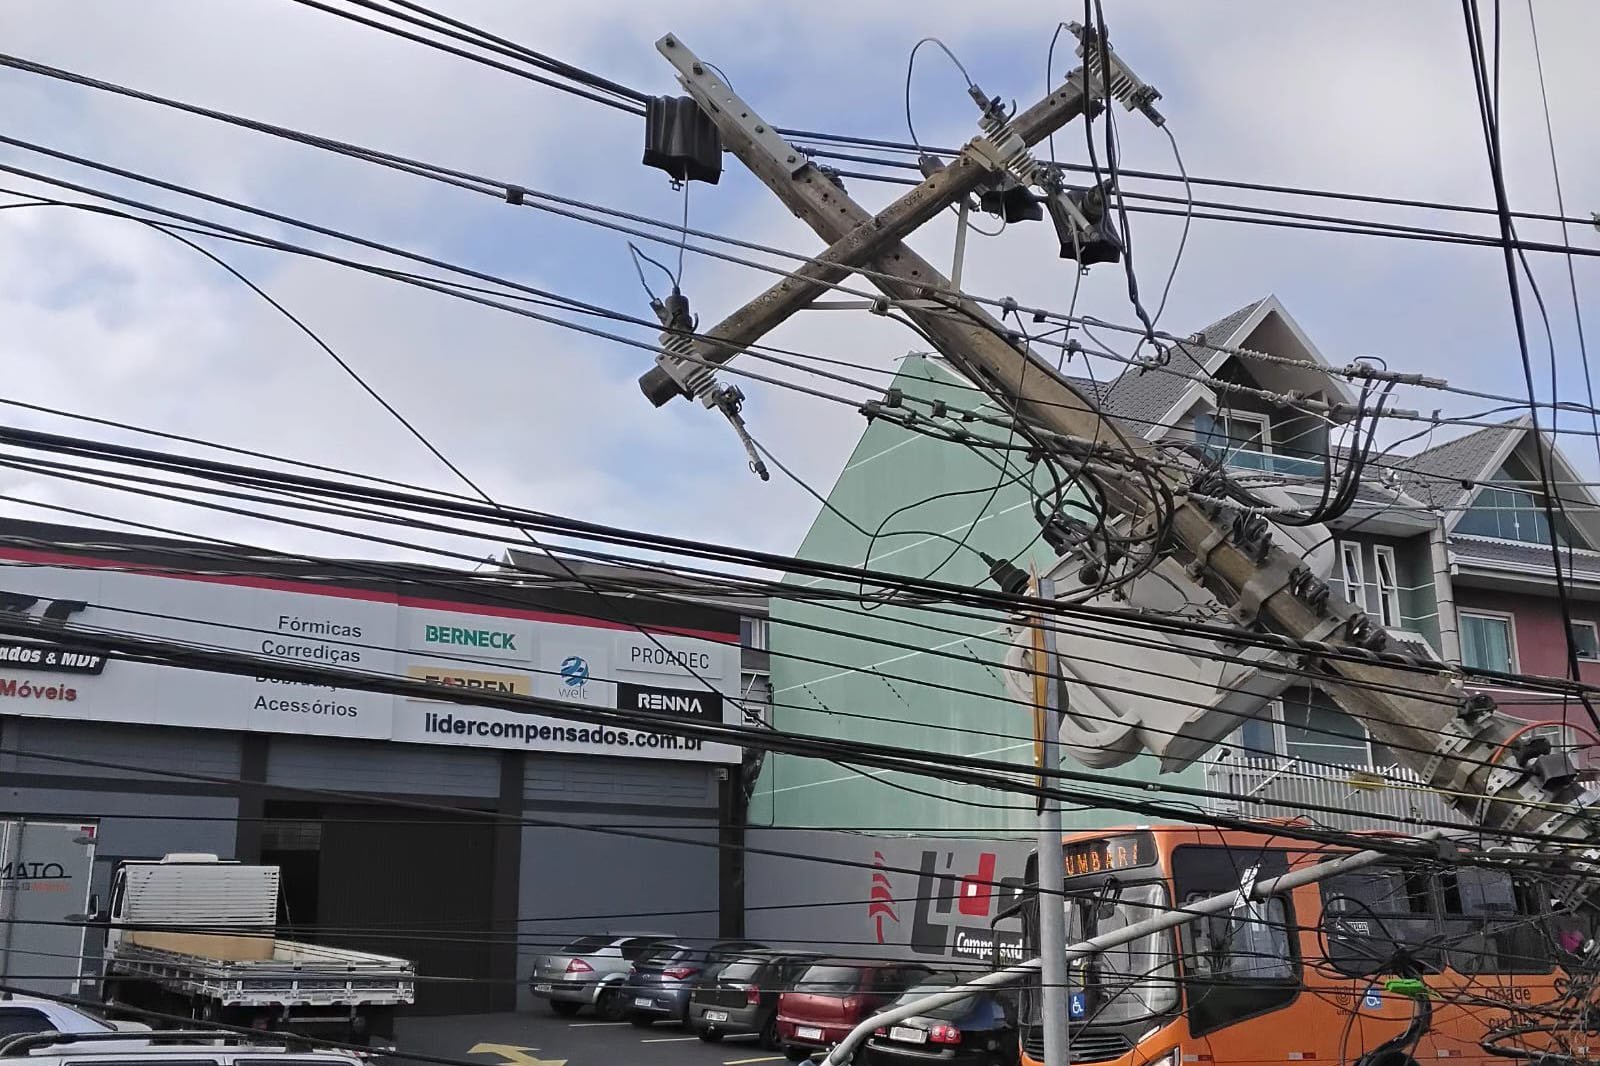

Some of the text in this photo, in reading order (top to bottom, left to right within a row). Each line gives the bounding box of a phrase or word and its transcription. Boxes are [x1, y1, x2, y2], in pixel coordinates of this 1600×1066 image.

[278, 615, 362, 638] Fórmicas
[425, 624, 517, 651] BERNECK
[45, 652, 57, 665] &
[261, 640, 361, 663] Corrediças
[631, 646, 710, 670] PROADEC
[254, 695, 358, 718] Acessórios
[637, 692, 703, 713] RENNA
